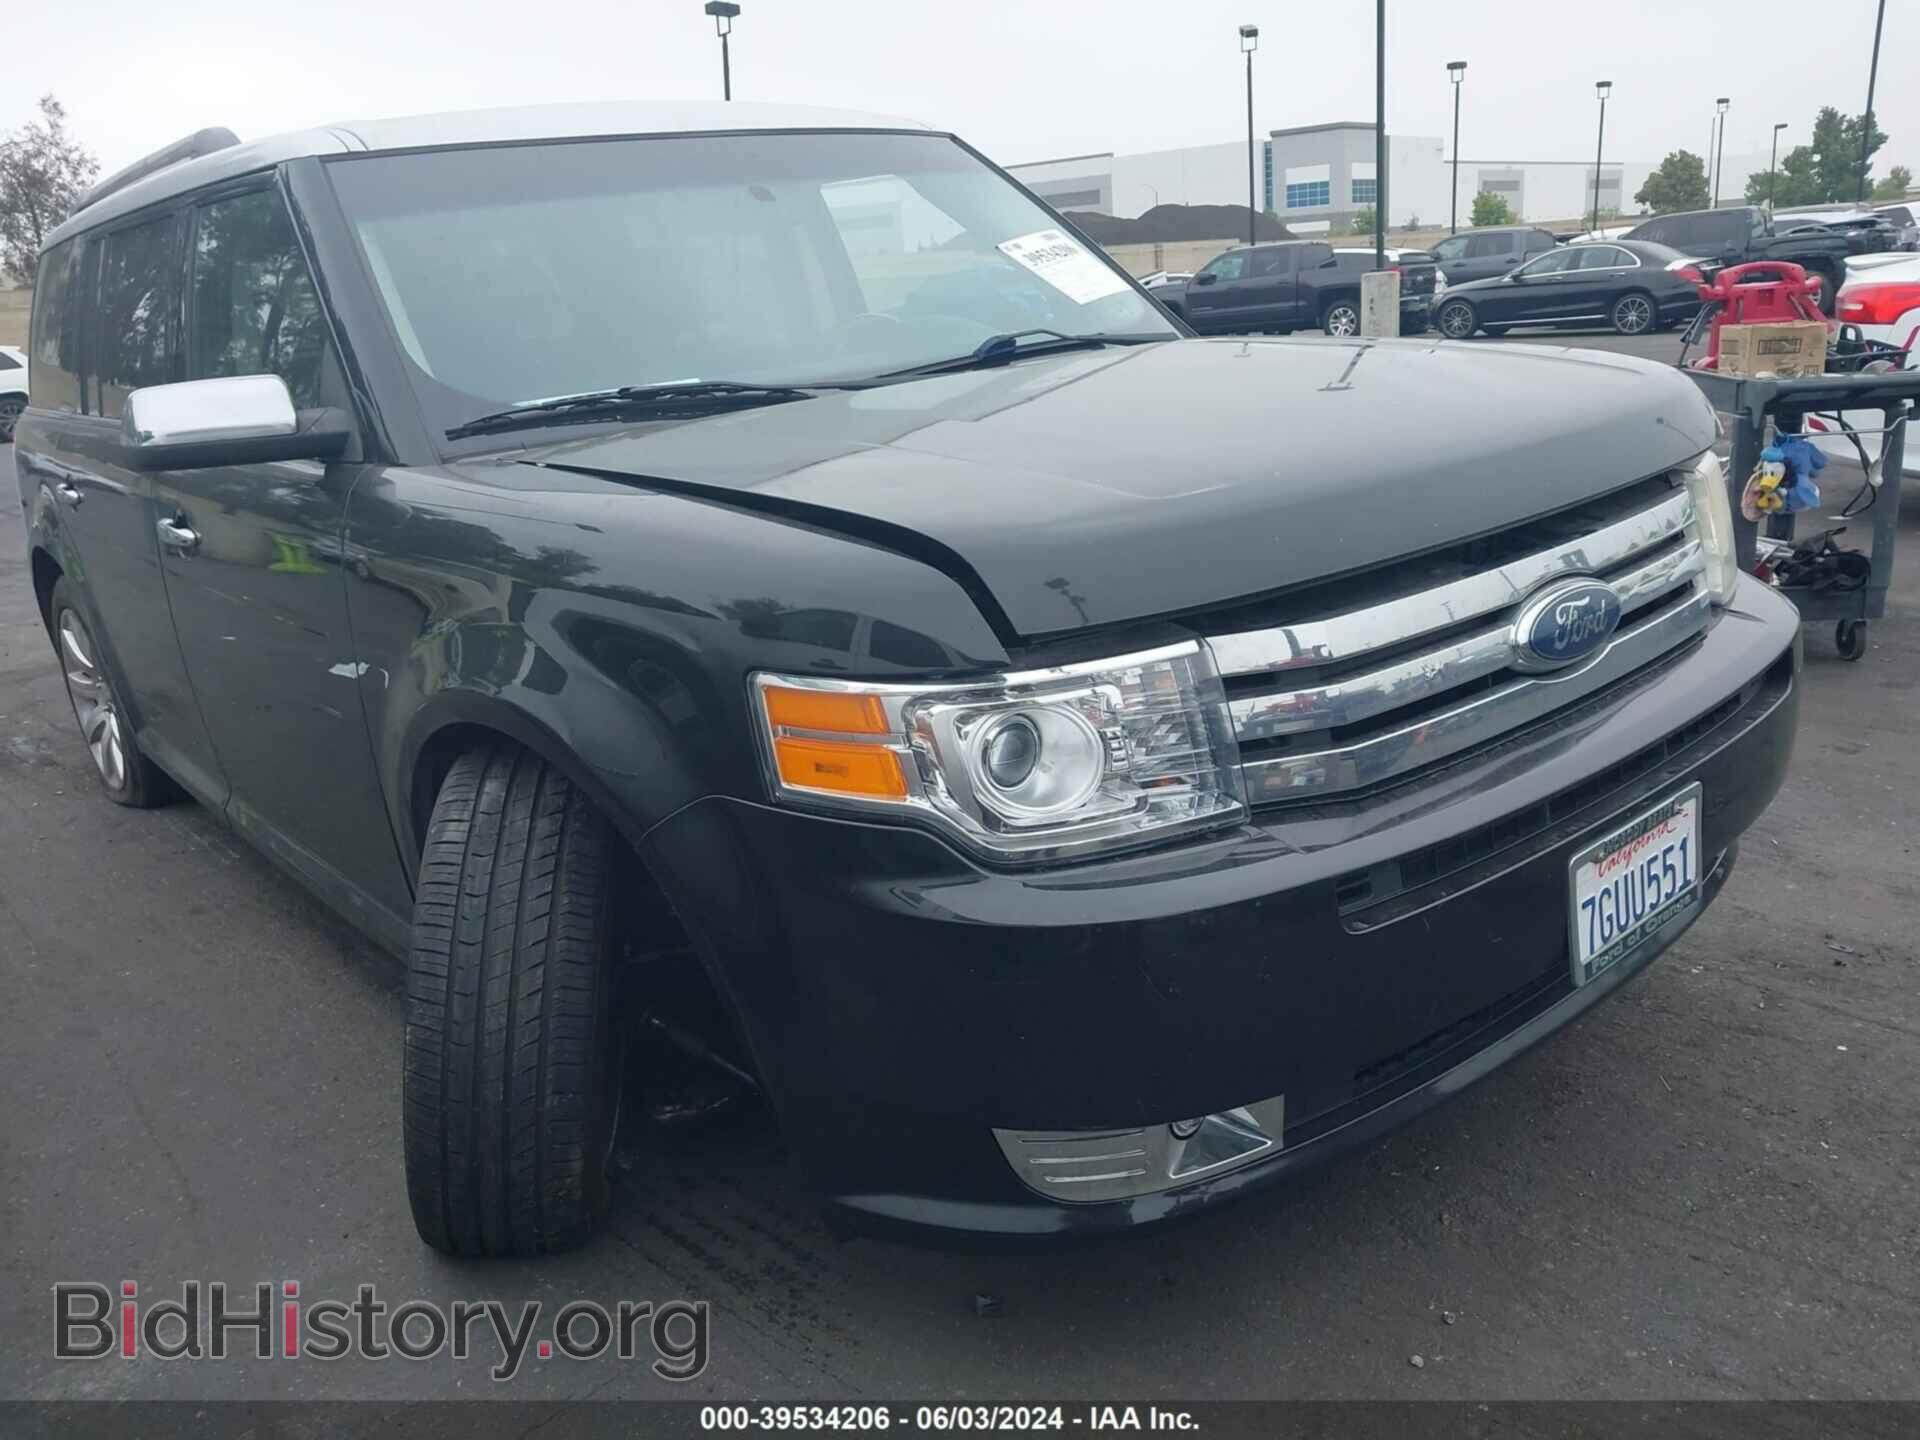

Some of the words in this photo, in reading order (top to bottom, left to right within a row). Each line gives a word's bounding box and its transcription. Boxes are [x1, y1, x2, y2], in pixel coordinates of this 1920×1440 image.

[1554, 595, 1606, 651] Ford
[1596, 819, 1677, 878] California
[1581, 836, 1692, 956] 7GUU551
[1591, 943, 1624, 975] Ford
[1627, 927, 1642, 946] of
